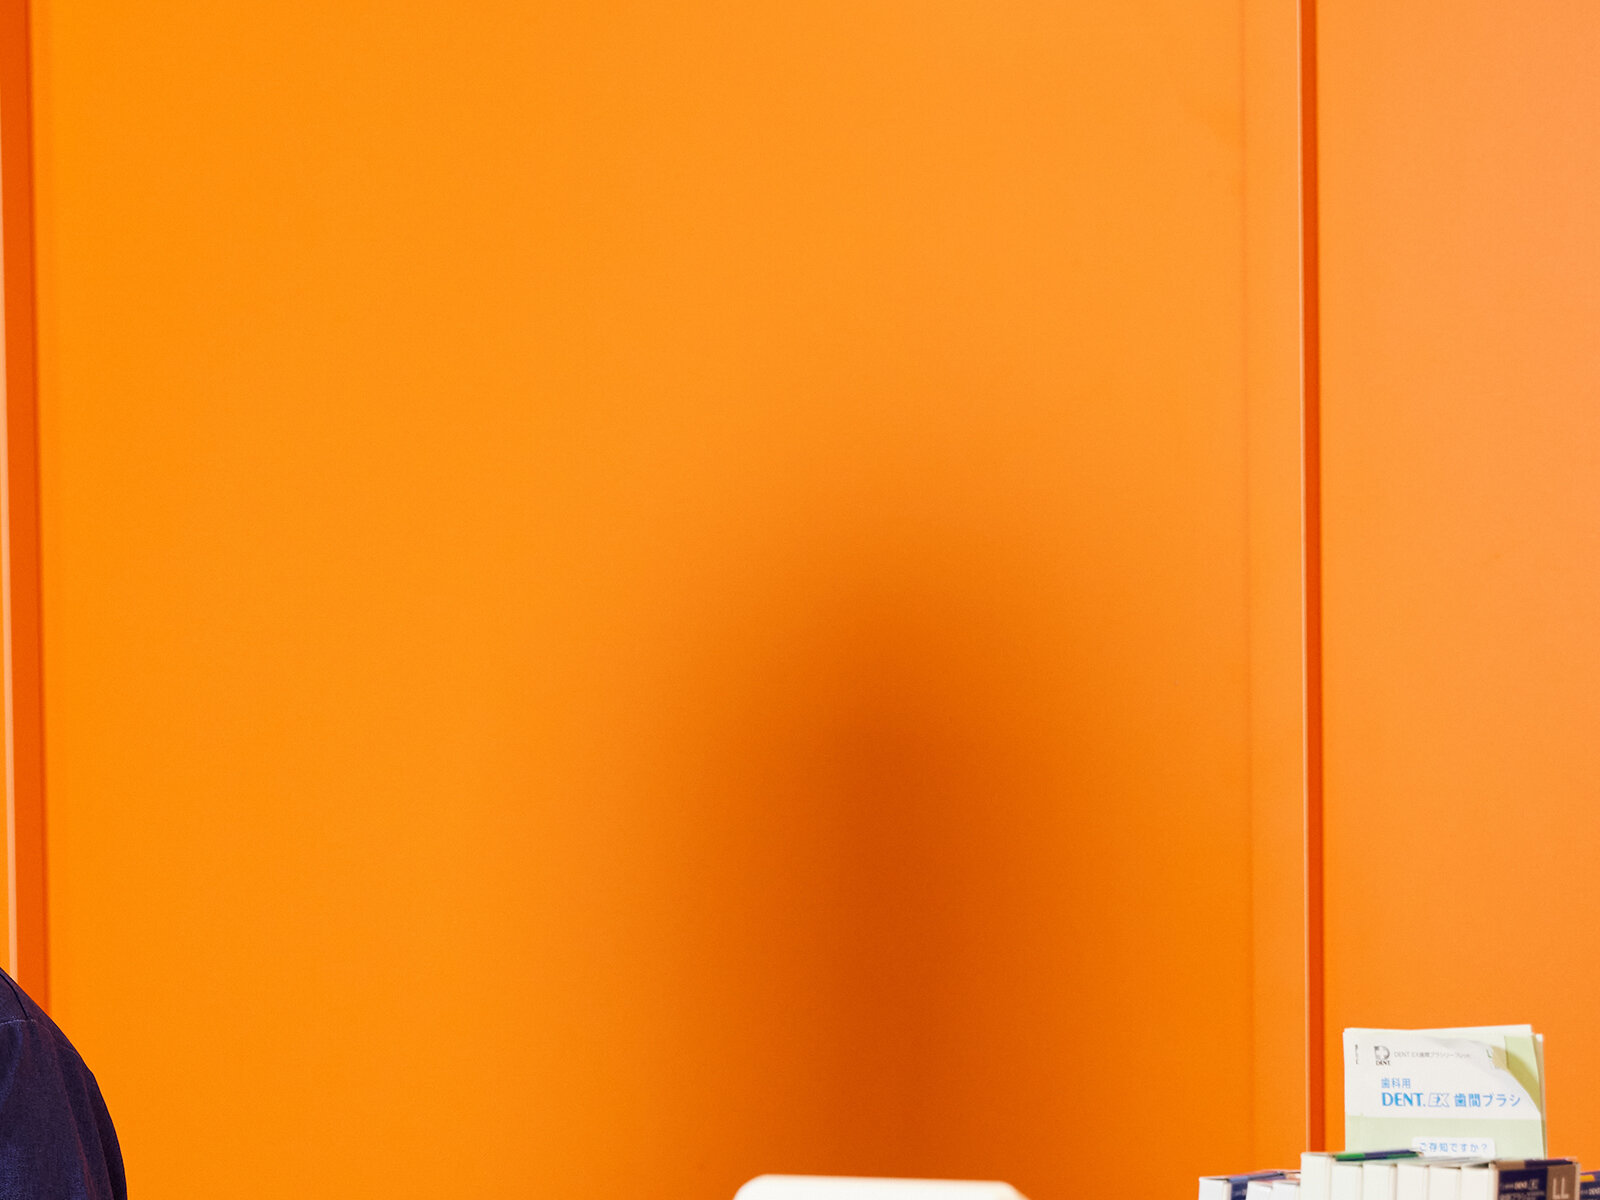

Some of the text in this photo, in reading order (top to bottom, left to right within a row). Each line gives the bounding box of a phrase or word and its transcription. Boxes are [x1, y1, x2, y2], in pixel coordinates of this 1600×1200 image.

[1381, 1077, 1412, 1090] 歯科用
[1454, 1093, 1521, 1108] 歯間ブラシ
[1419, 1141, 1489, 1154] ご存知ですか？
[1552, 1177, 1569, 1200] LL
